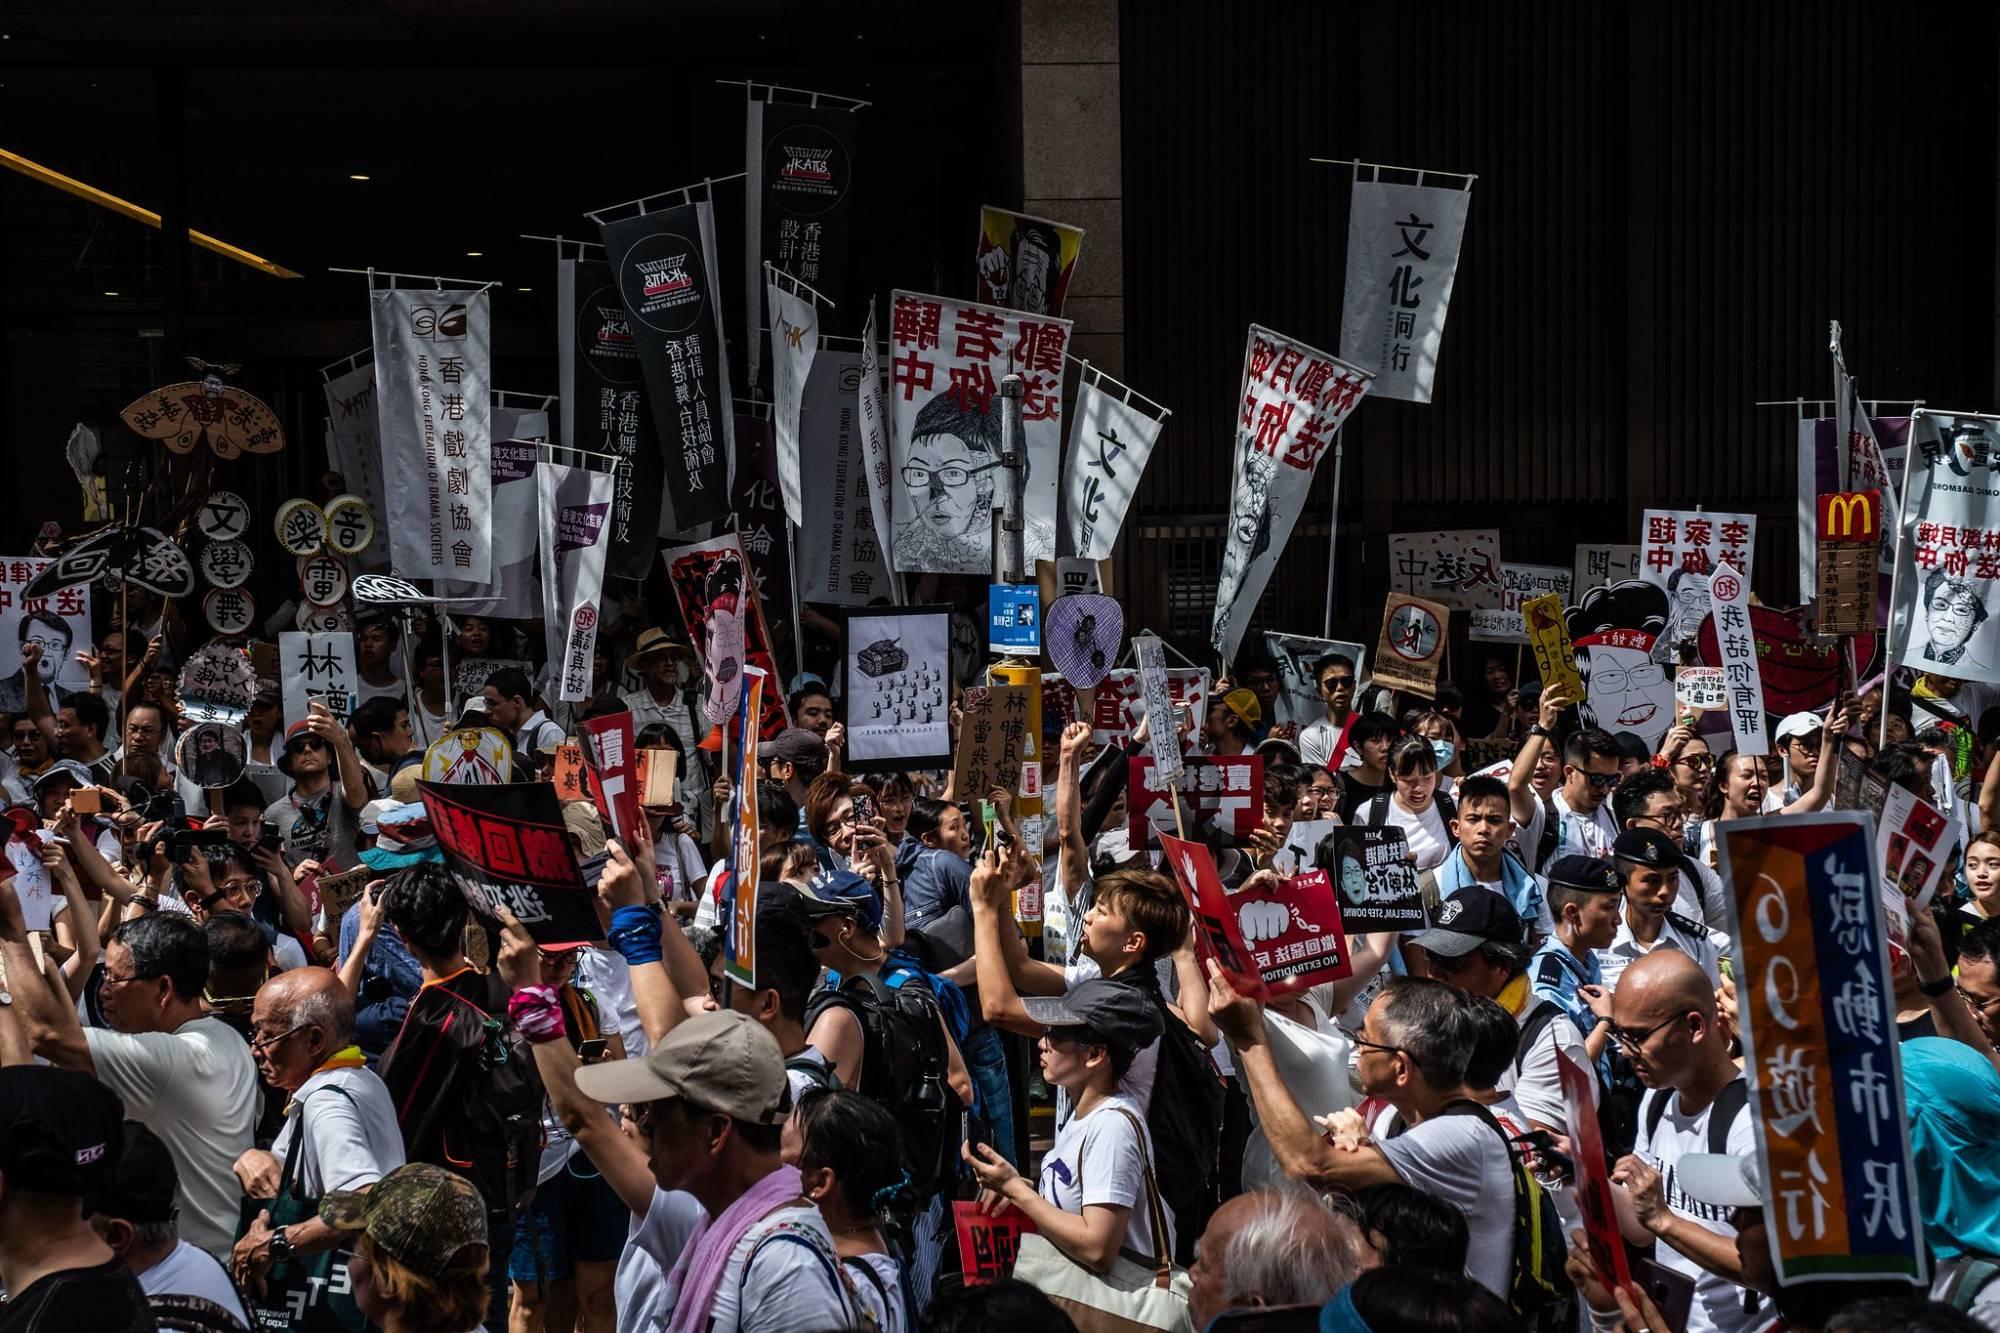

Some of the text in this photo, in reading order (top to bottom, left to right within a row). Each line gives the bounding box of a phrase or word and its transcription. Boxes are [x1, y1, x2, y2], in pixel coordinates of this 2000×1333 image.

[1388, 213, 1434, 373] 文化同行
[597, 318, 632, 341] HKA
[418, 354, 429, 381] HONG
[420, 384, 432, 411] KONG
[423, 415, 438, 470] FEDERATION
[438, 356, 473, 568] 香港戲劇協會
[430, 485, 441, 521] DRAMA
[431, 522, 443, 566] SOCIETIES
